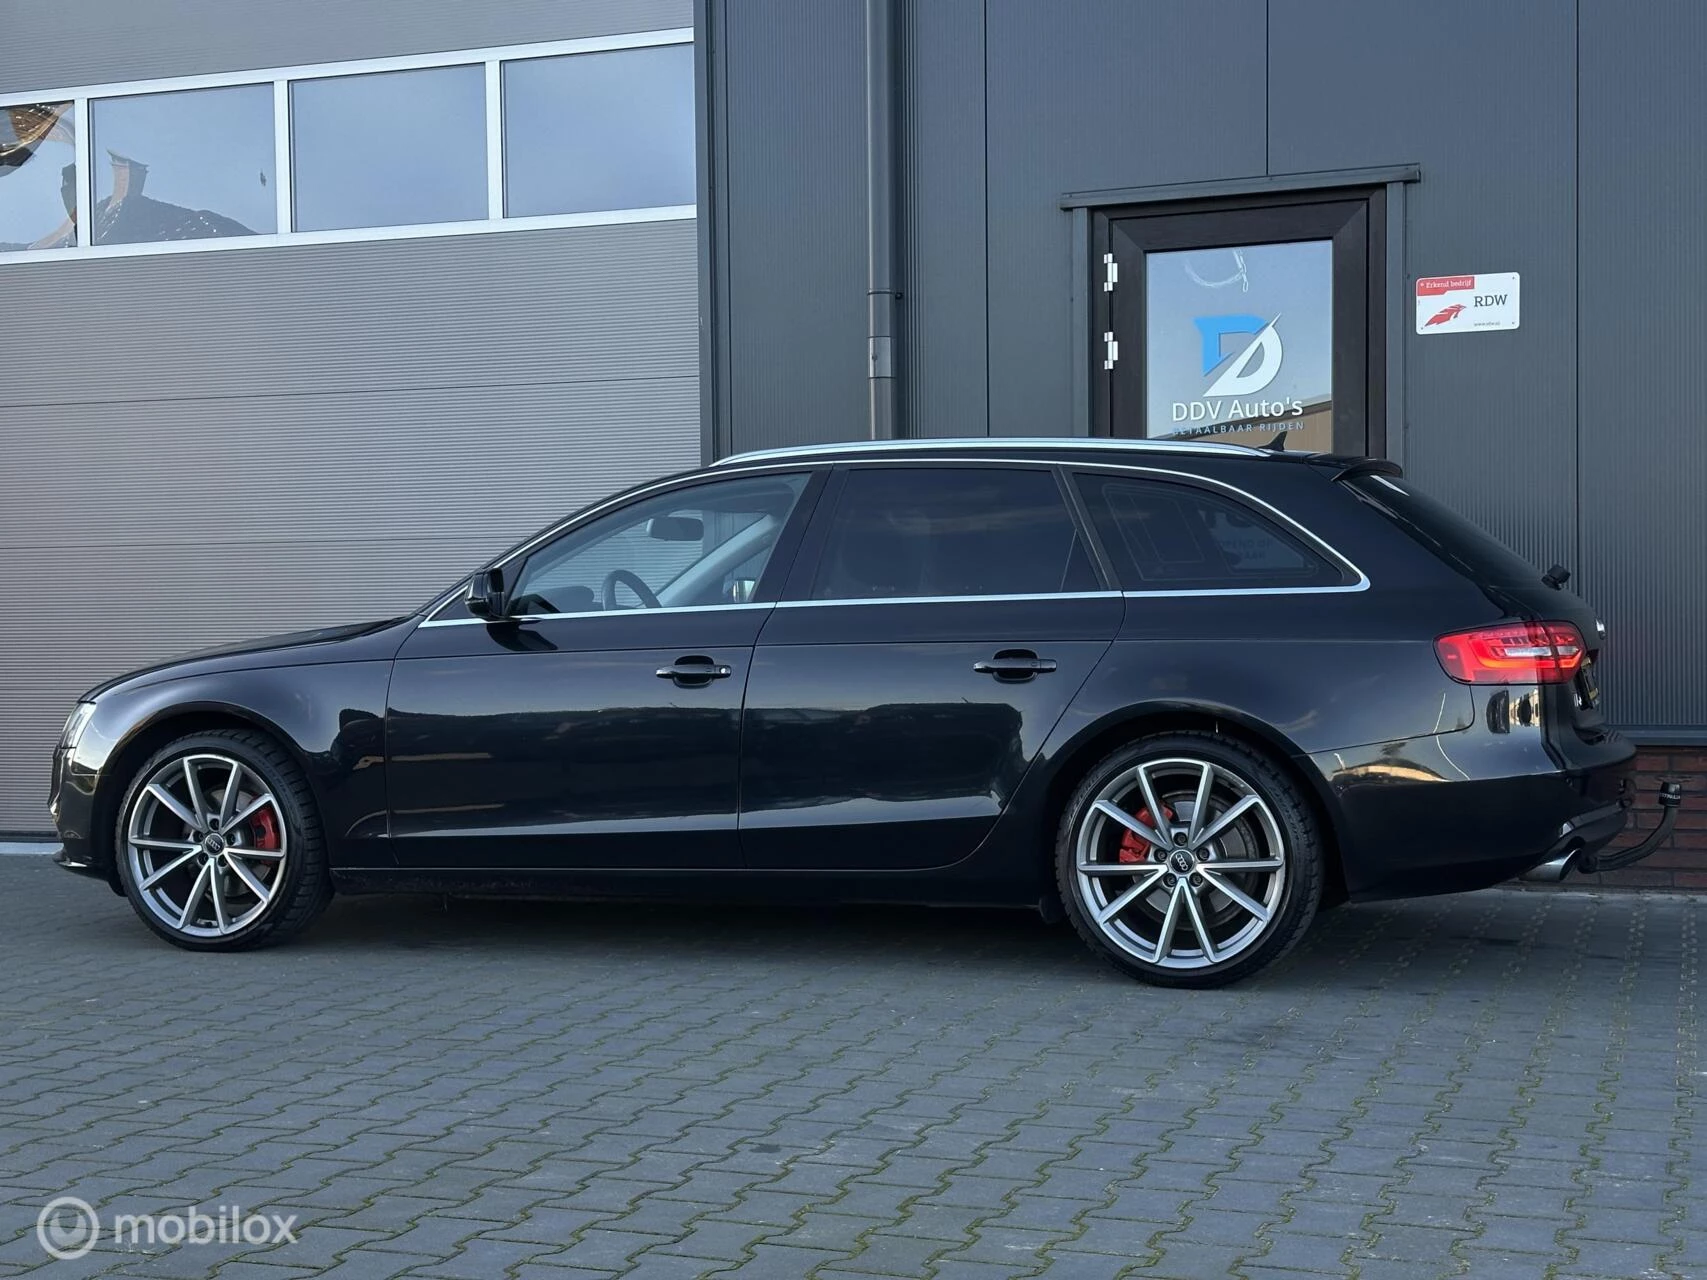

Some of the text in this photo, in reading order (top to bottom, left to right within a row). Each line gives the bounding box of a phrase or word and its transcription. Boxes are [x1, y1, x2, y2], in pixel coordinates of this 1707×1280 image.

[1474, 294, 1508, 307] RDW
[1173, 396, 1304, 422] DDV Auto's
[1258, 421, 1304, 432] RIJDEN
